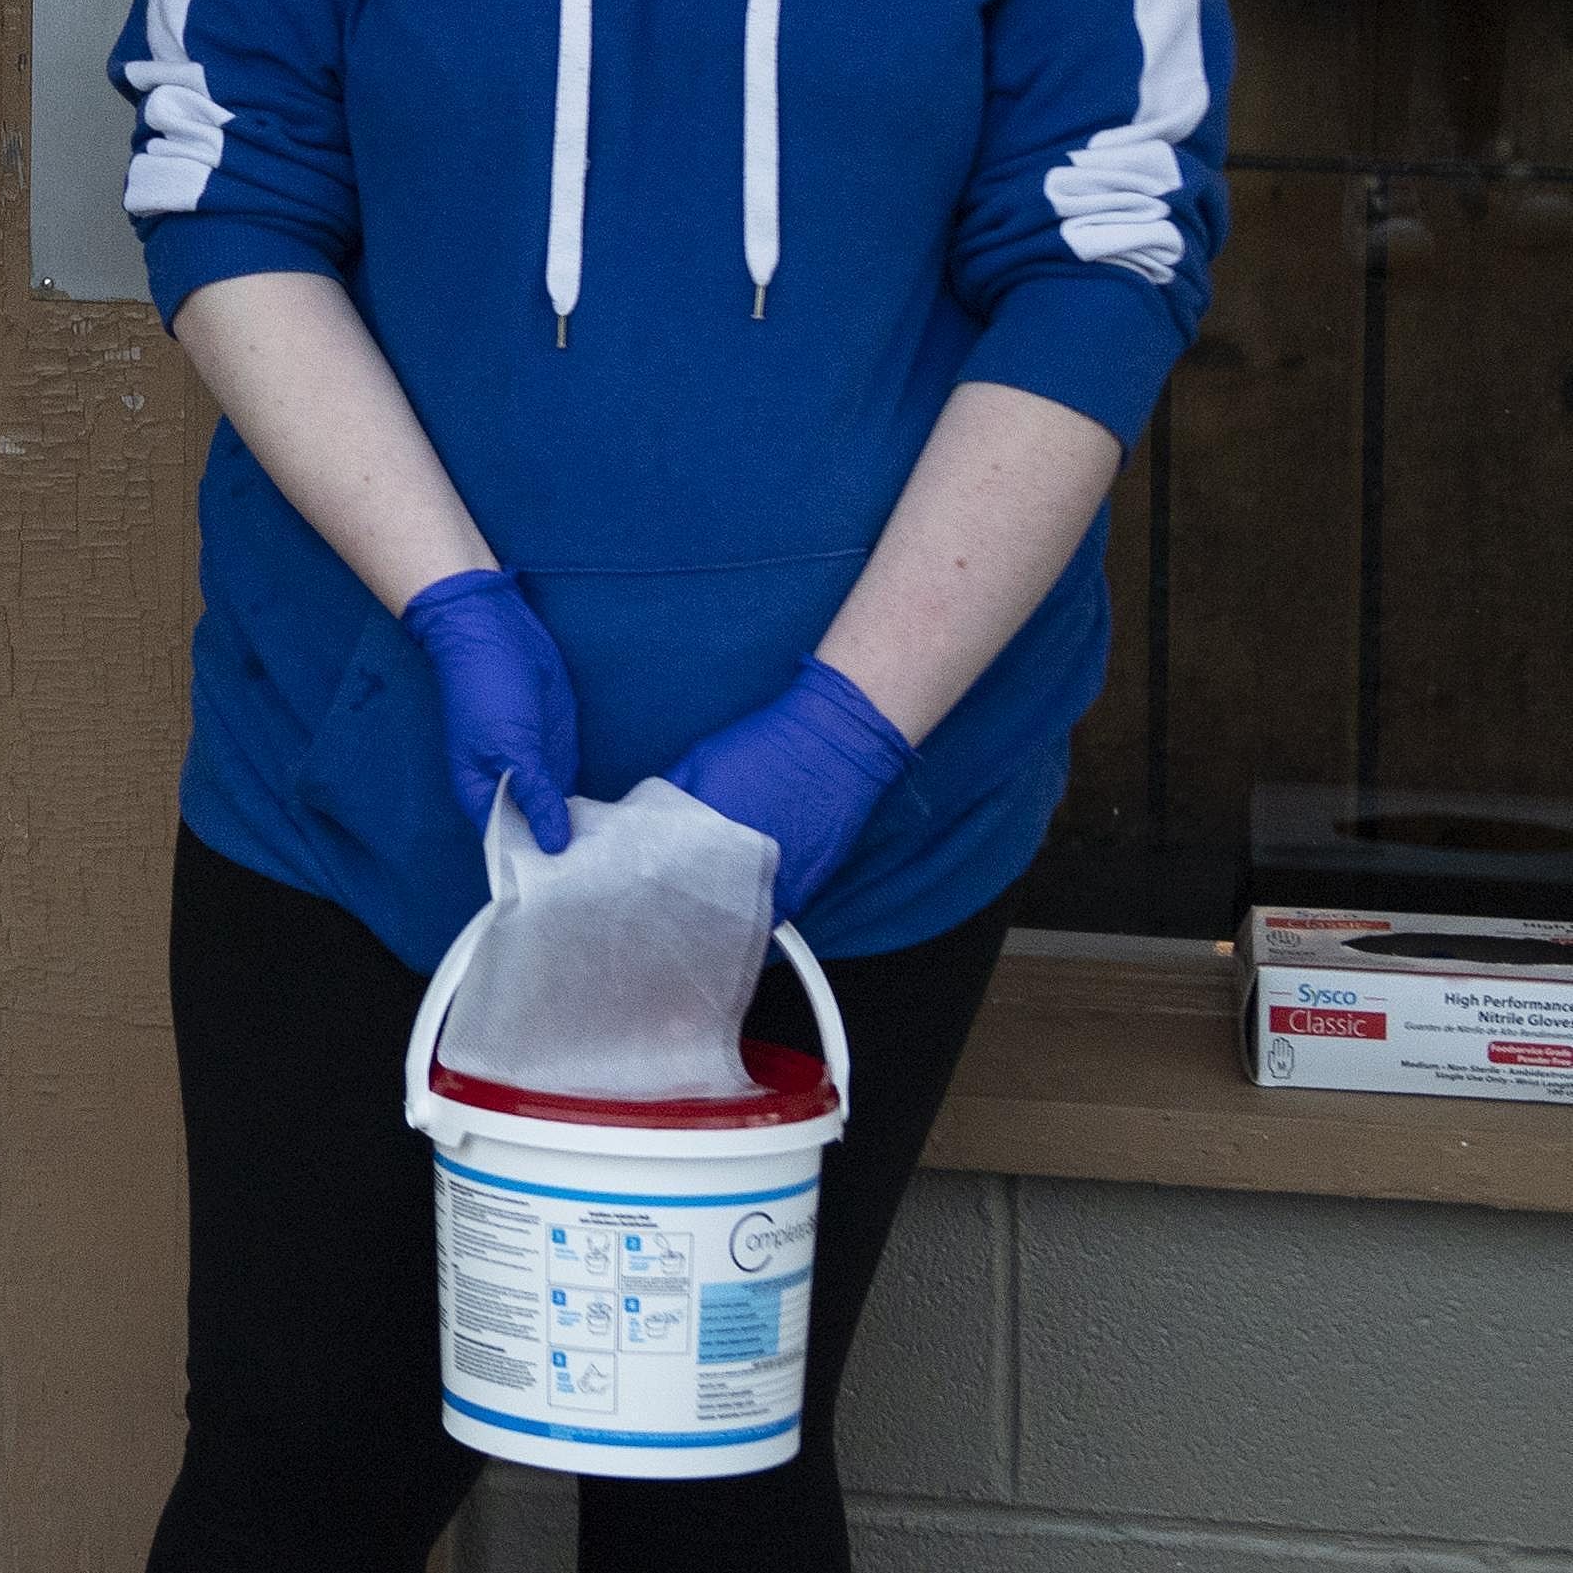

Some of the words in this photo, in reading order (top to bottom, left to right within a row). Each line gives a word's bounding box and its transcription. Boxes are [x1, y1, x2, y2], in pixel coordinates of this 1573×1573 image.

[1298, 983, 1358, 1006] Sysco
[1444, 992, 1480, 1009] High
[1288, 1010, 1367, 1037] Classic
[1478, 1011, 1525, 1026] Nitrile
